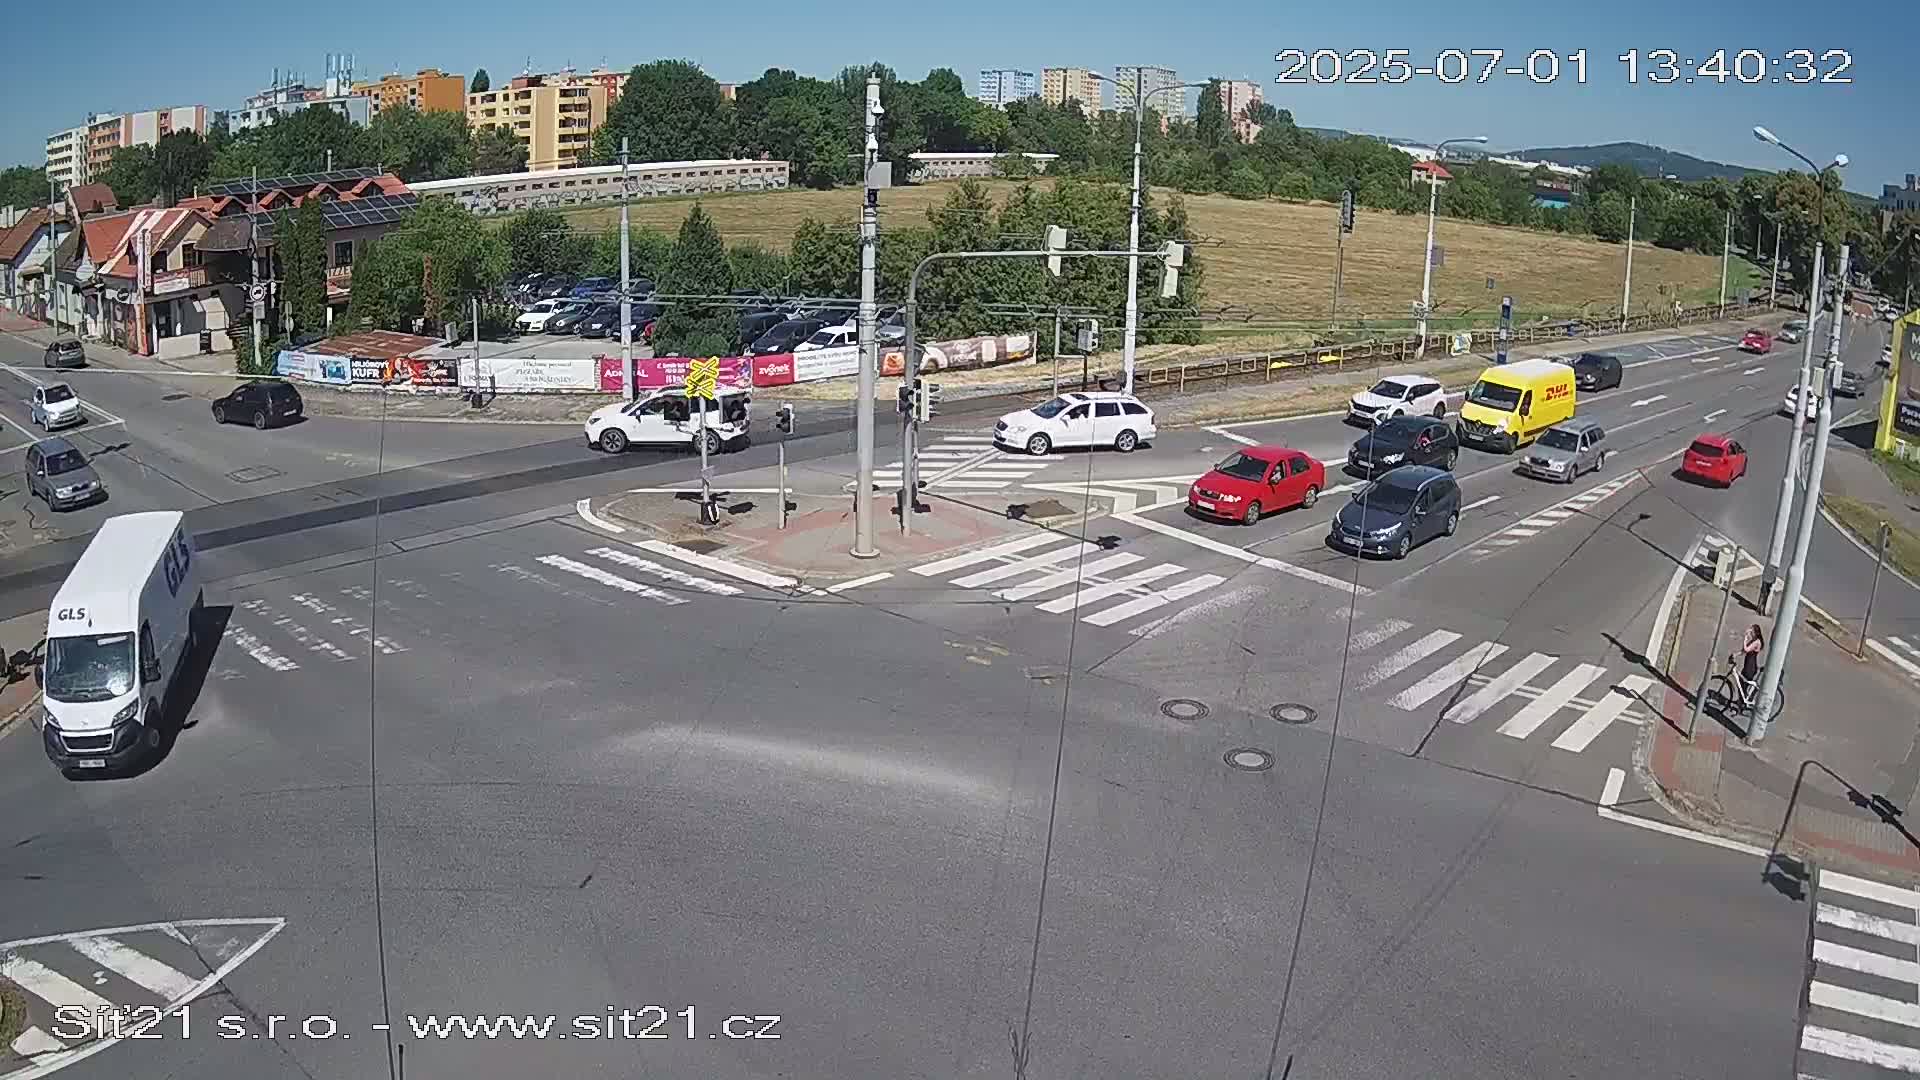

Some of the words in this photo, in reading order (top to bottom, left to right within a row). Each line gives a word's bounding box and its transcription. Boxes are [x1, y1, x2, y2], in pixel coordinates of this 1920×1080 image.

[352, 368, 380, 378] KUFR
[1545, 383, 1568, 400] DHL
[165, 540, 190, 598] GLS
[57, 607, 86, 621] GLS
